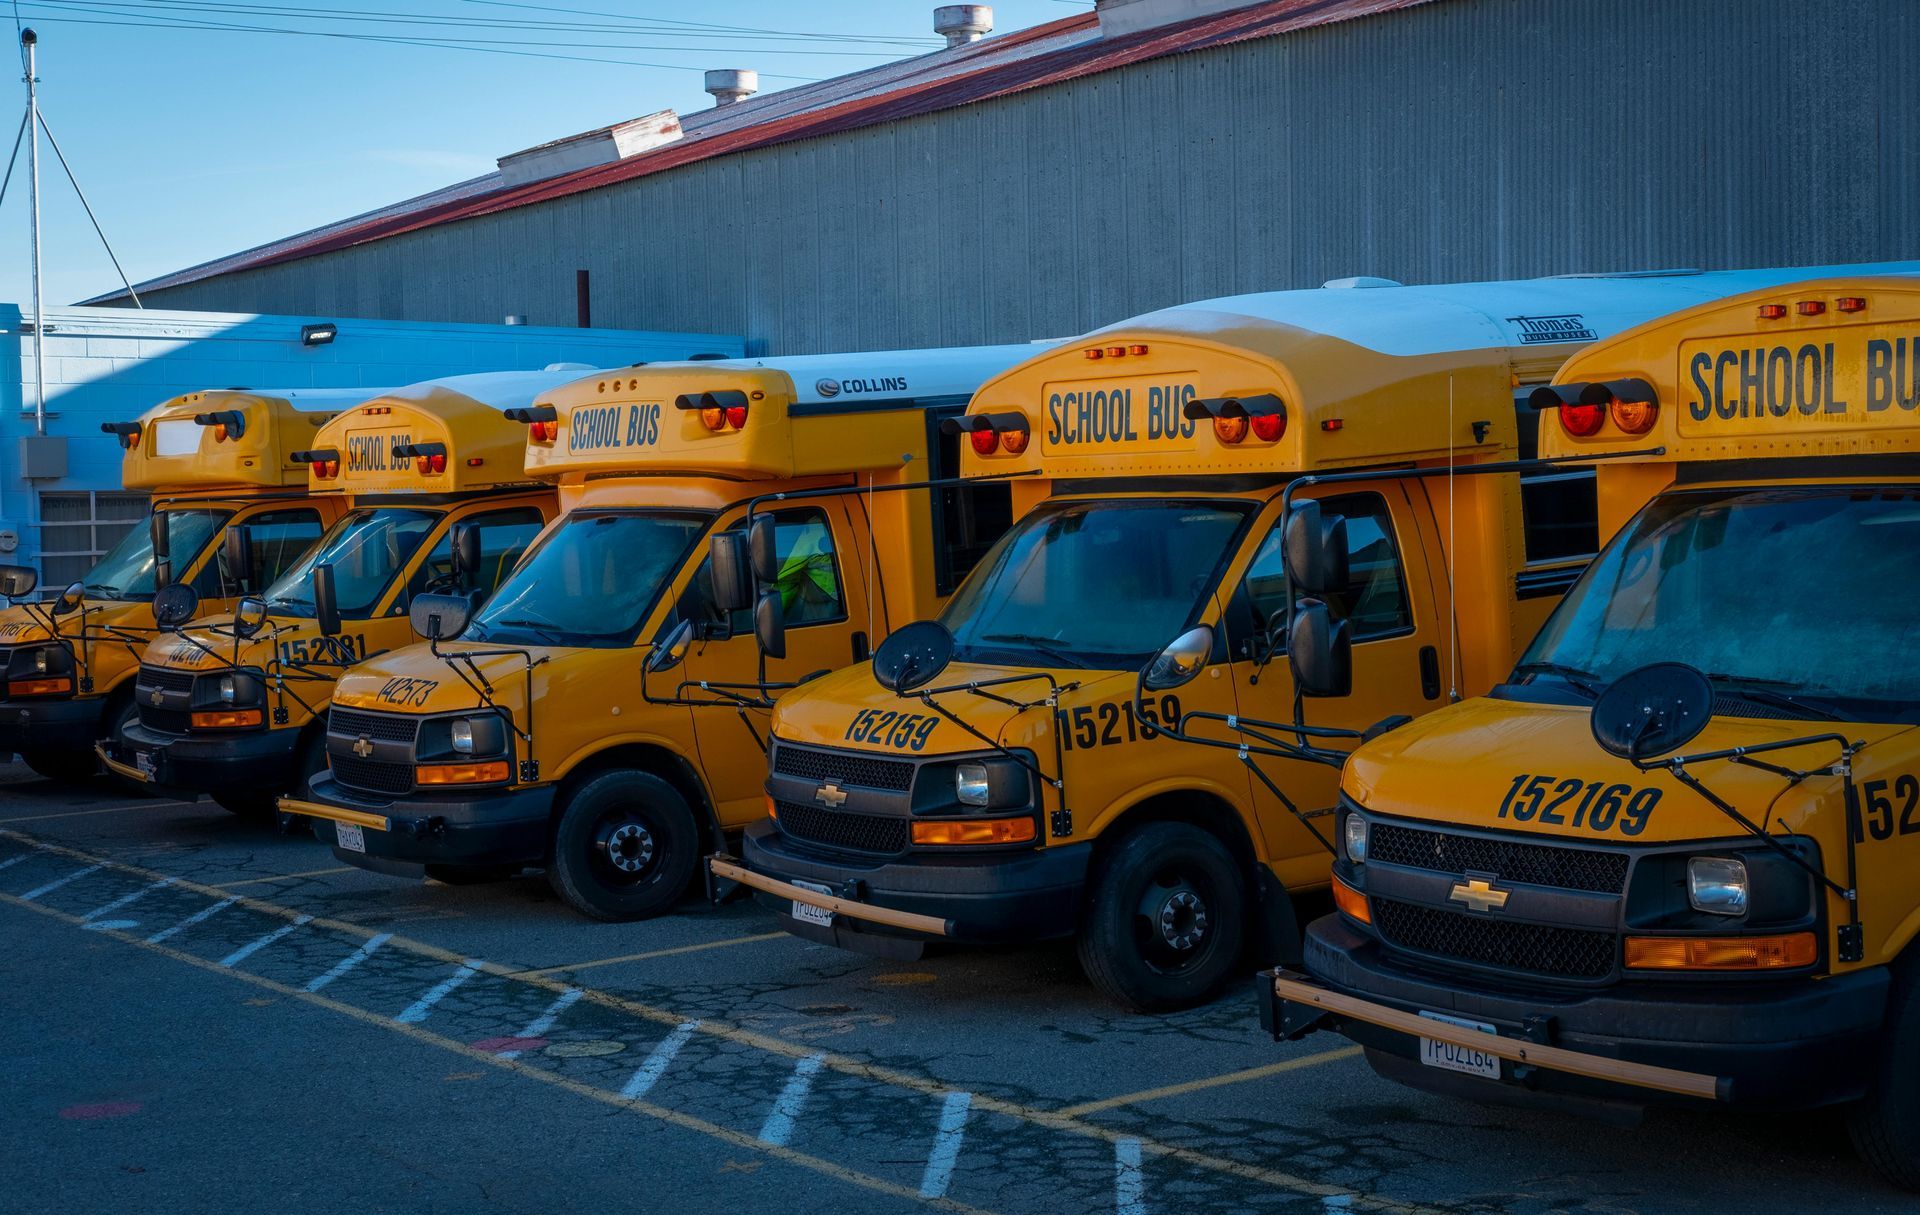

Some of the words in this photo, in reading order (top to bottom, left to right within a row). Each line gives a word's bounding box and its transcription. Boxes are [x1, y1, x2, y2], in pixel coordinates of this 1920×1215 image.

[1505, 314, 1585, 333] Thomas
[1526, 333, 1553, 341] BUILT
[1557, 331, 1590, 339] BUSES
[842, 377, 907, 393] COLLINS
[1690, 343, 1847, 421] SCHOOL
[571, 407, 621, 450] SCHOOL
[627, 404, 660, 446] BUS
[1049, 389, 1137, 444] SCHOOL
[1149, 384, 1196, 440] BUS
[348, 436, 386, 471] SCHOOL
[390, 435, 411, 471] BUS
[376, 677, 439, 707] 142573
[845, 709, 940, 751] 152159
[1058, 695, 1180, 751] 152159
[1497, 775, 1663, 836] 152169
